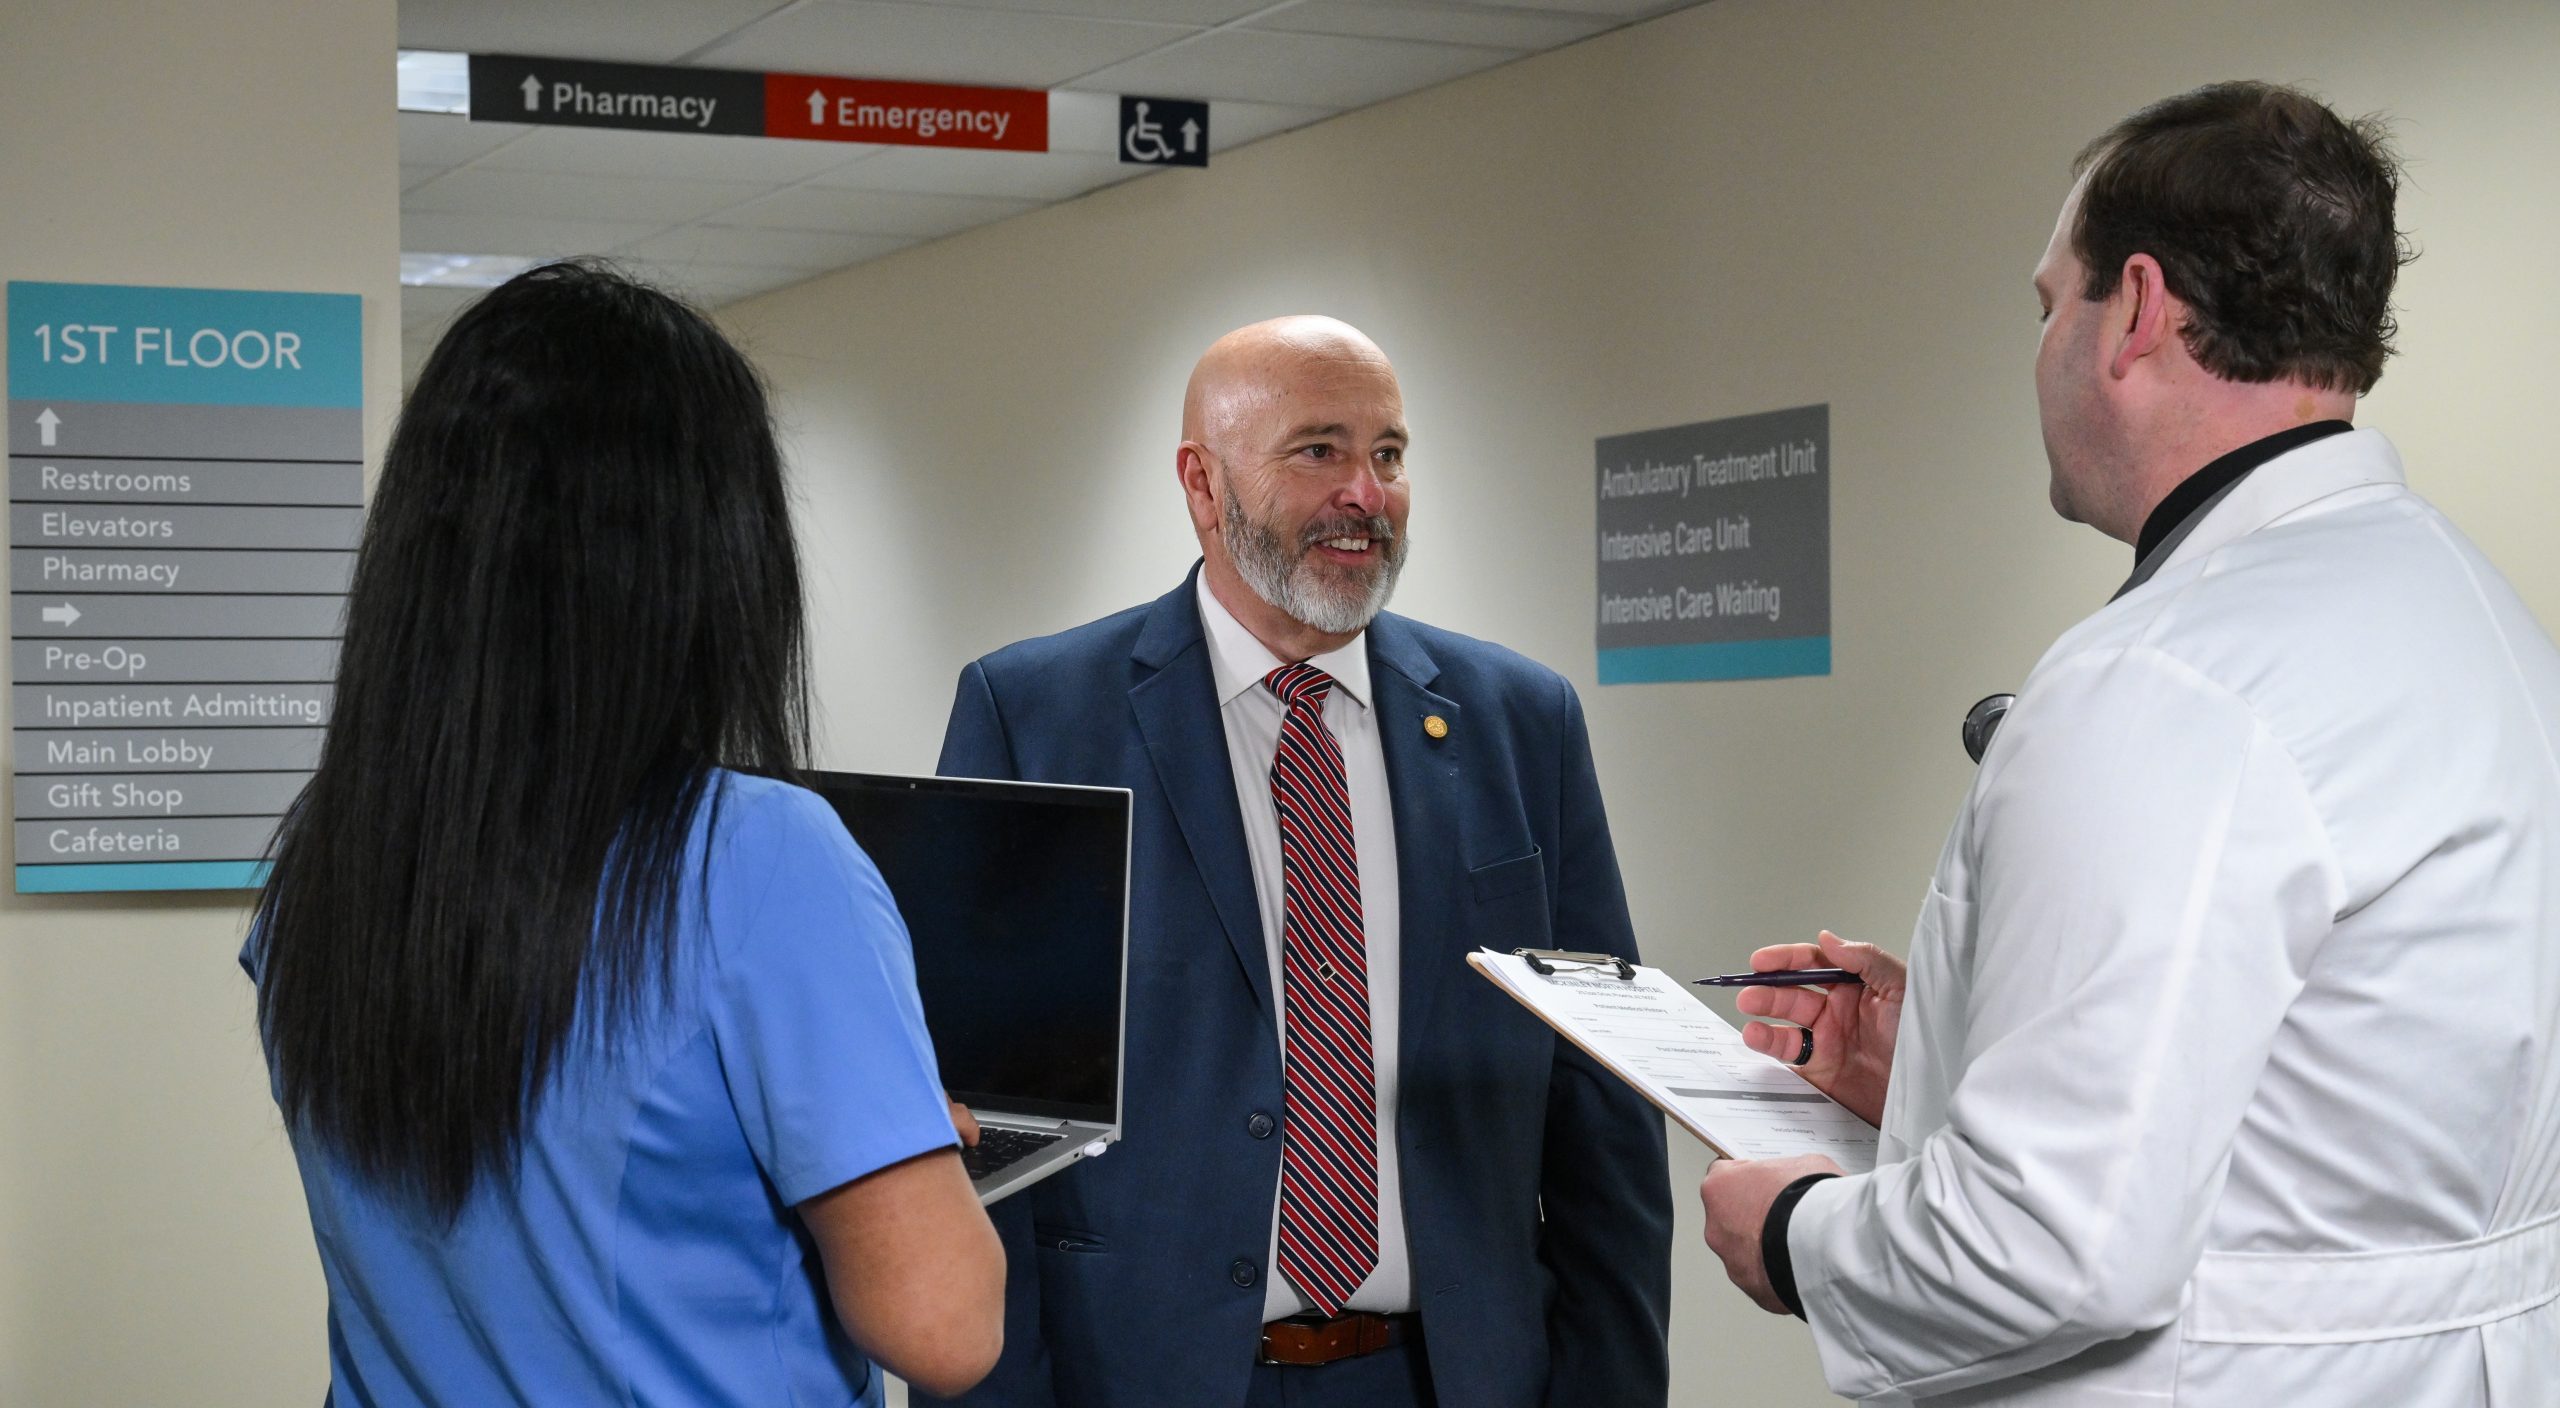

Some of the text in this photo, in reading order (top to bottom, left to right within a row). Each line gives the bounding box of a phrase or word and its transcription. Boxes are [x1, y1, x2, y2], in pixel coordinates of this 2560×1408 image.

[553, 82, 717, 127] Pharmacy
[838, 97, 1010, 140] Emergency
[34, 324, 302, 370] 1ST FLOOR
[41, 466, 191, 492] Restrooms
[1601, 439, 1817, 499] Ambulatory Treatment Unit
[42, 512, 173, 538] Elevators
[1601, 514, 1750, 562] Intensive Care Unit
[43, 556, 180, 588] Pharmacy
[1601, 579, 1781, 625] Intensive Care Waiting
[45, 646, 146, 678] Pre-Op
[46, 692, 322, 725] Inpatient Admitting
[47, 739, 214, 769] Main Lobby
[48, 782, 183, 814] Gift Shop
[49, 828, 180, 853] Cafeteria
